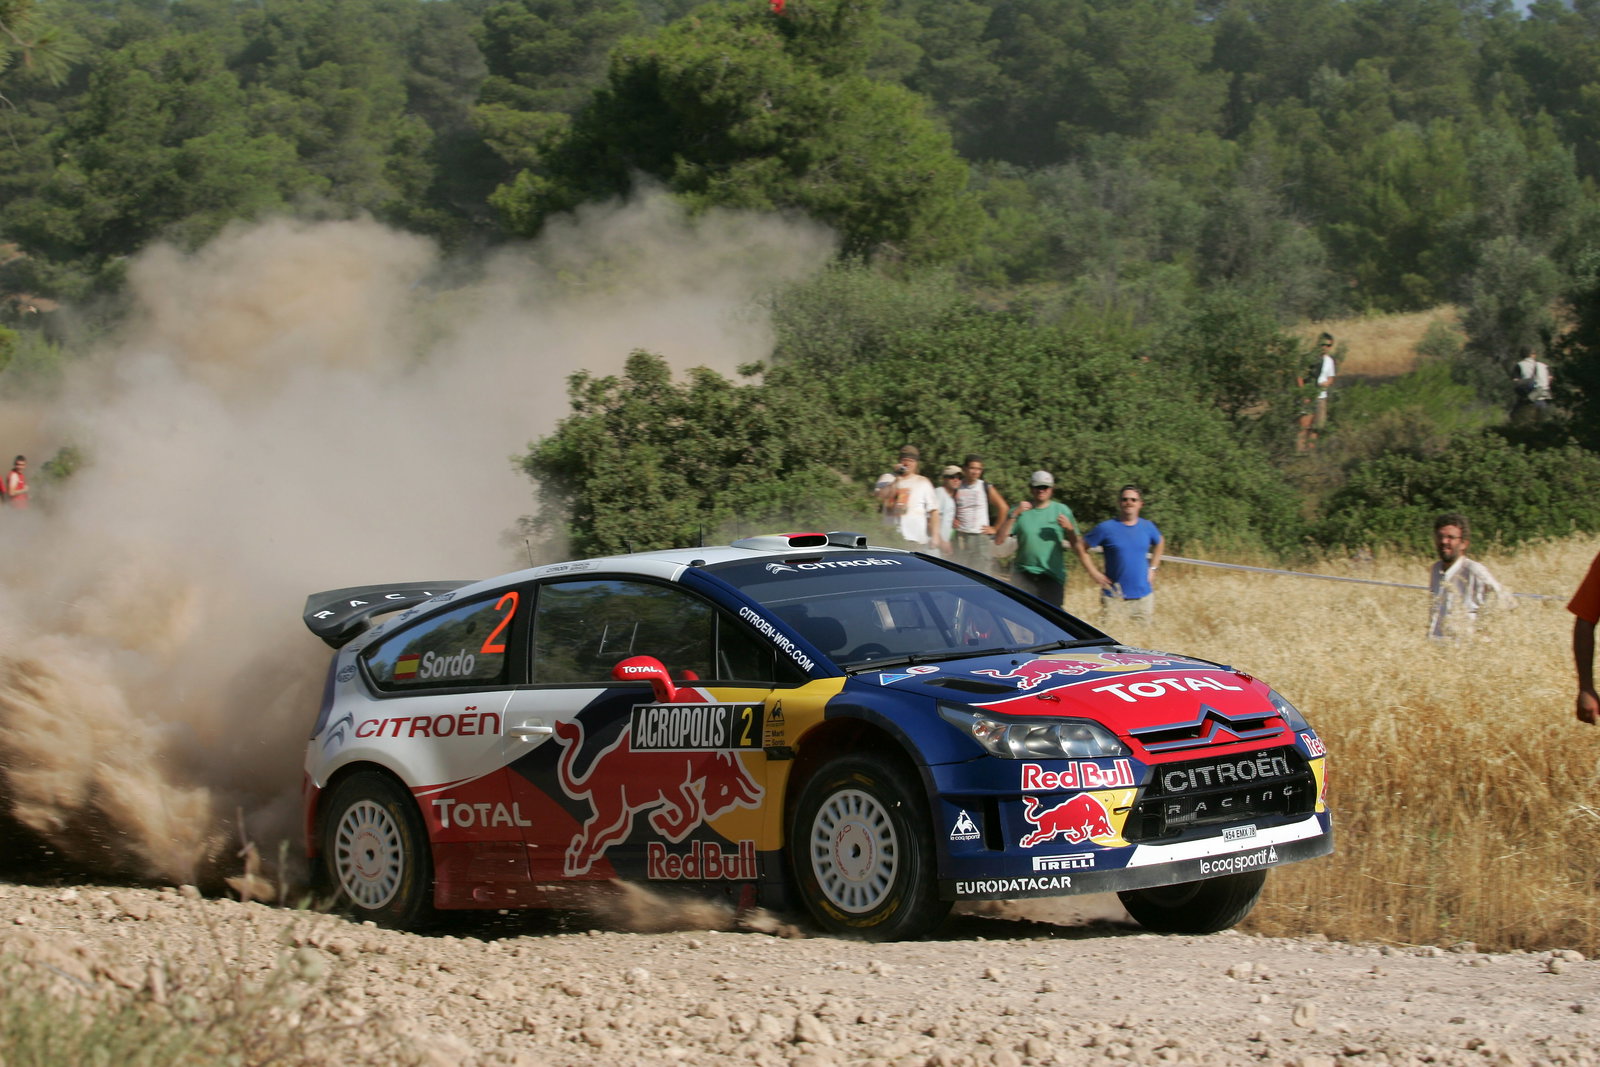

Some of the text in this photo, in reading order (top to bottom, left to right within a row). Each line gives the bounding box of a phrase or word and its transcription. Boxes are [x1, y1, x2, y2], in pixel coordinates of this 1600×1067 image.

[798, 557, 902, 570] CITROËN
[313, 591, 432, 619] RACI
[480, 591, 519, 653] 2
[739, 606, 815, 672] CITROEN-WRC.COM
[420, 649, 475, 678] Sordo
[622, 665, 658, 673] TOTAL
[1092, 676, 1243, 703] TOTAL
[355, 706, 500, 737] CITROËN
[636, 706, 753, 747] ACROPOLIS 2
[1021, 758, 1135, 790] Red Bull
[1164, 752, 1291, 792] CITROËN
[431, 799, 532, 828] TOTAL
[1168, 785, 1293, 815] RACING
[1225, 832, 1235, 840] 454
[1236, 829, 1248, 838] EMX
[648, 840, 758, 880] Red Bull
[1032, 853, 1095, 871] PIRELLI
[1200, 849, 1268, 874] le coq sportif
[956, 876, 1072, 895] EURODATACAR
